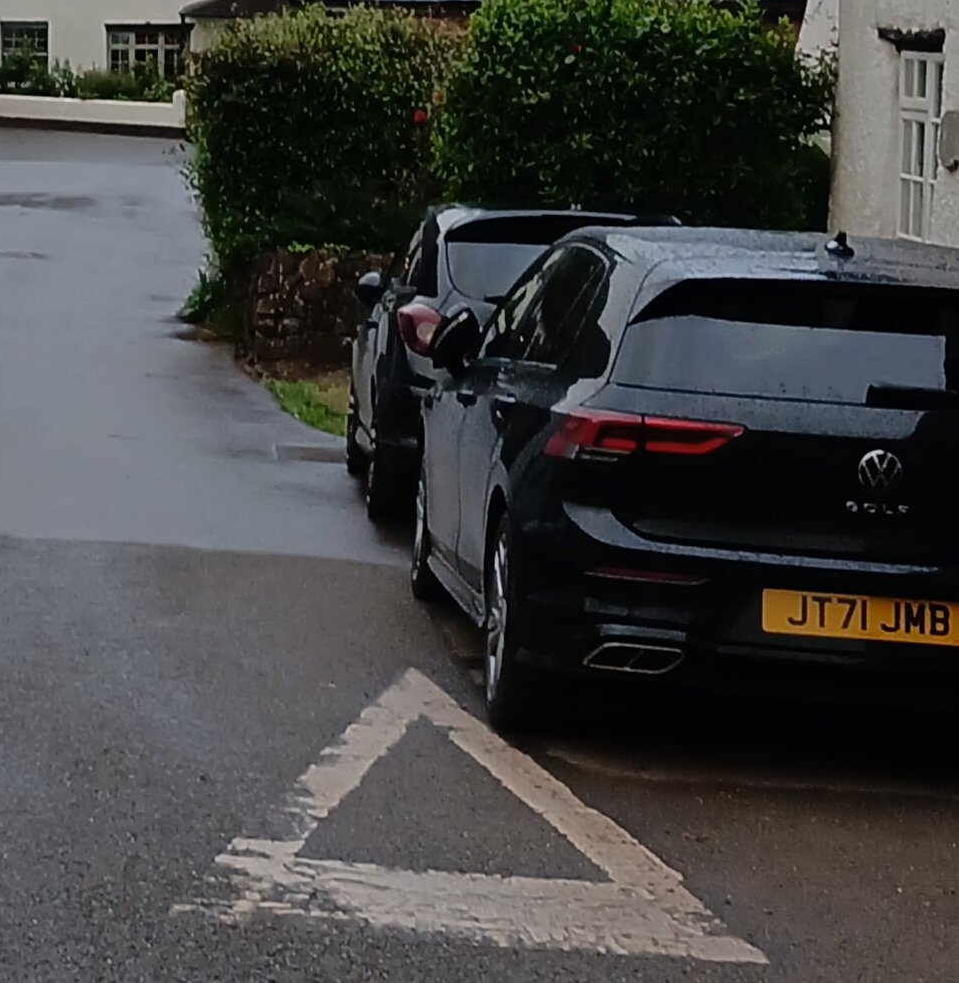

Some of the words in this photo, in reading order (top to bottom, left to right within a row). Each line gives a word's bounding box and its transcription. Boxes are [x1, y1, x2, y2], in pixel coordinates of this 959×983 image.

[845, 500, 909, 515] GOLF
[787, 594, 868, 631] JT71
[880, 600, 950, 636] JMB
